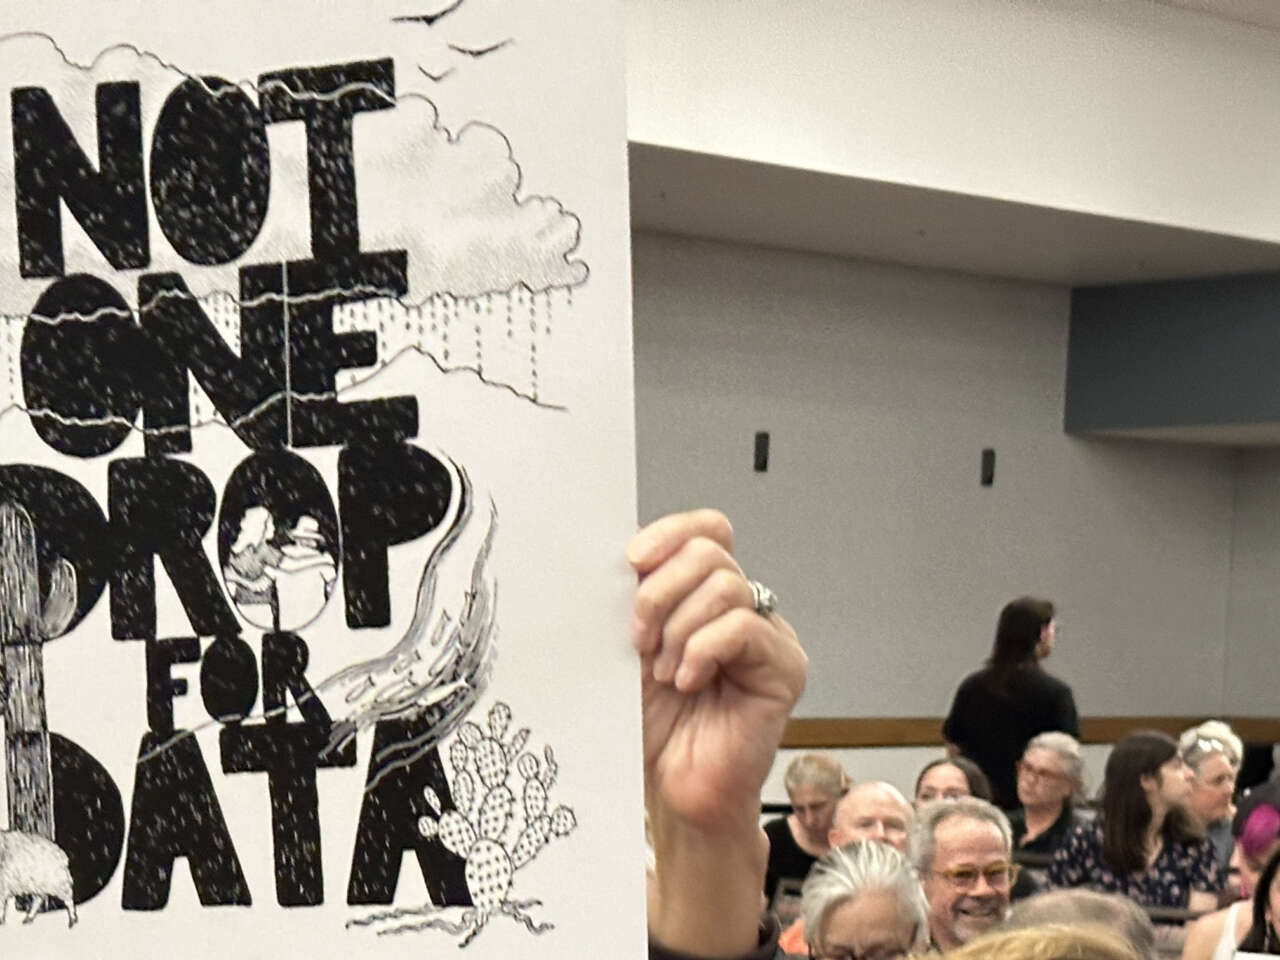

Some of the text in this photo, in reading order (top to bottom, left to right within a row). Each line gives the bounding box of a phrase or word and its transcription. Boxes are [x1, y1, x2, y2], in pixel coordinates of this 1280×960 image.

[10, 57, 396, 279] NOT
[20, 250, 419, 458] ONE
[147, 631, 333, 734] FOR
[10, 720, 476, 910] DATA
